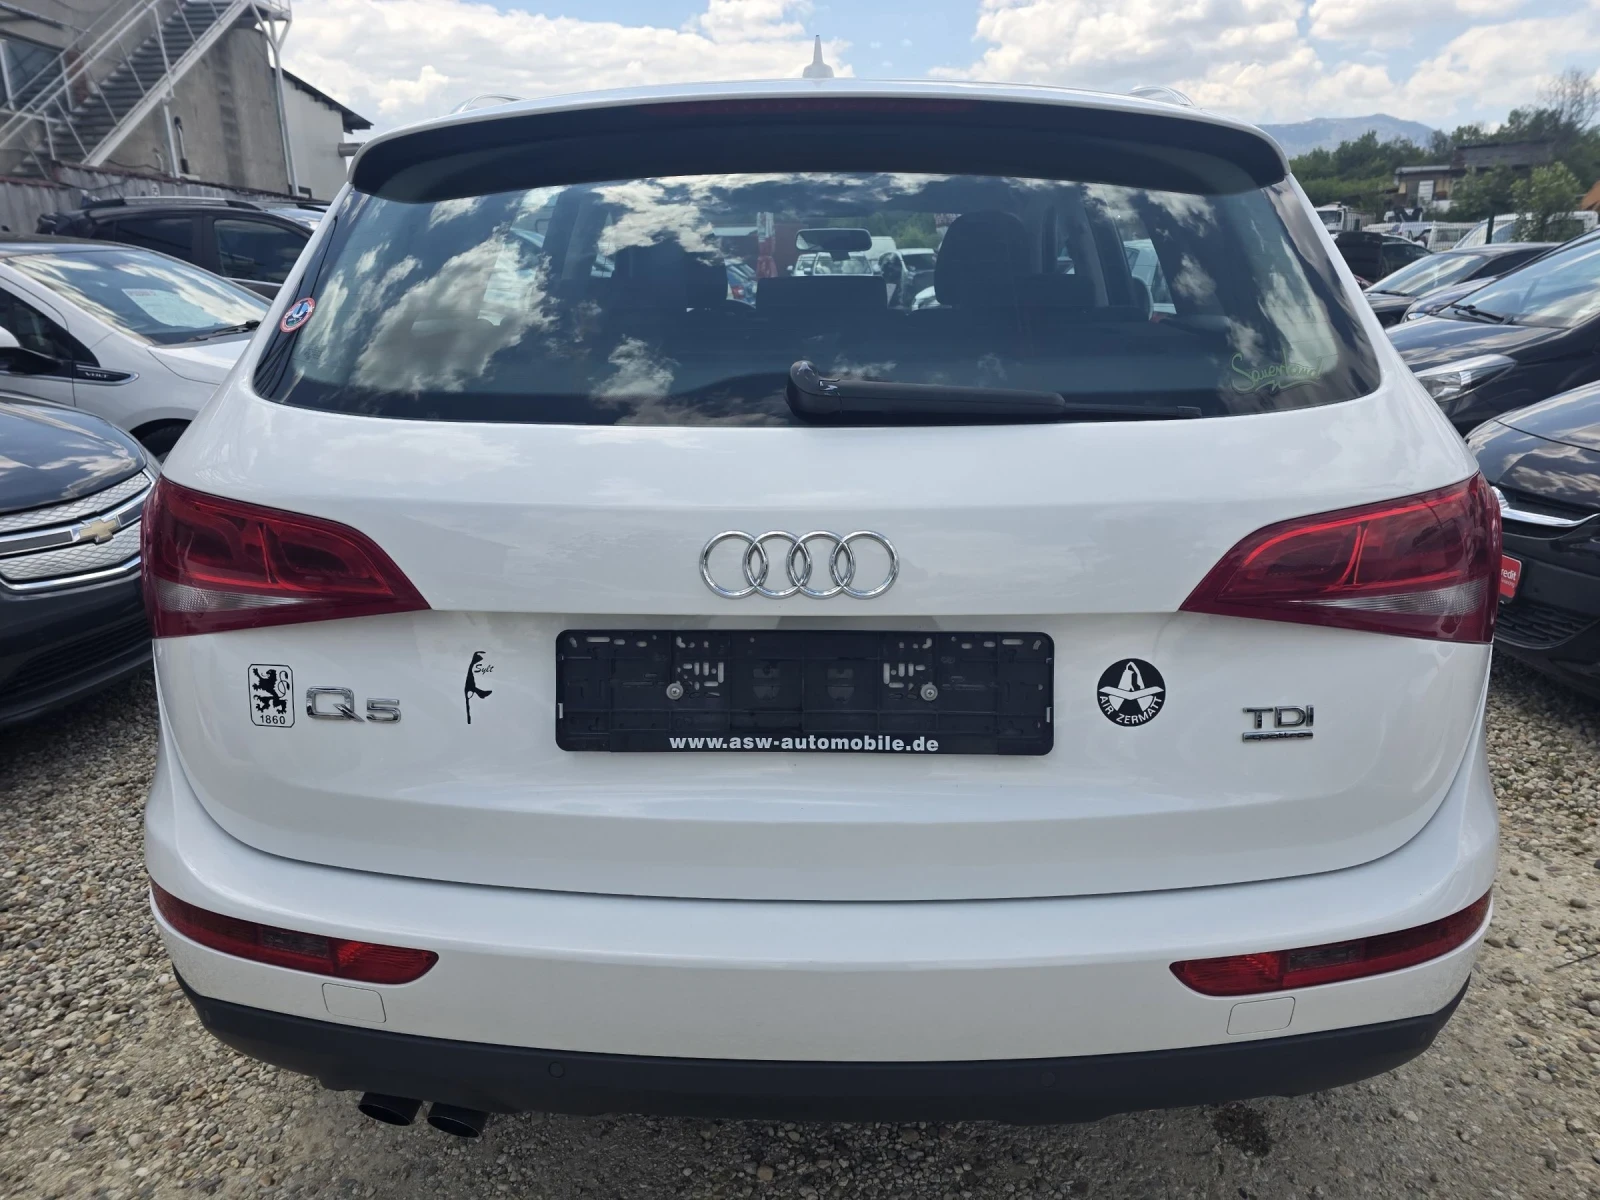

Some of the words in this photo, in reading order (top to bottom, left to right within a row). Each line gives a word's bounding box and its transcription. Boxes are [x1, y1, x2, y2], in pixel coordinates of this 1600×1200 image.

[473, 662, 495, 675] Sylt
[1099, 696, 1113, 716] AIR
[1116, 696, 1163, 724] ZERMATT
[1242, 704, 1315, 729] TDI
[259, 714, 286, 725] 1860
[669, 735, 940, 752] www.asw-automobile.de
[1250, 732, 1307, 742] quattro
